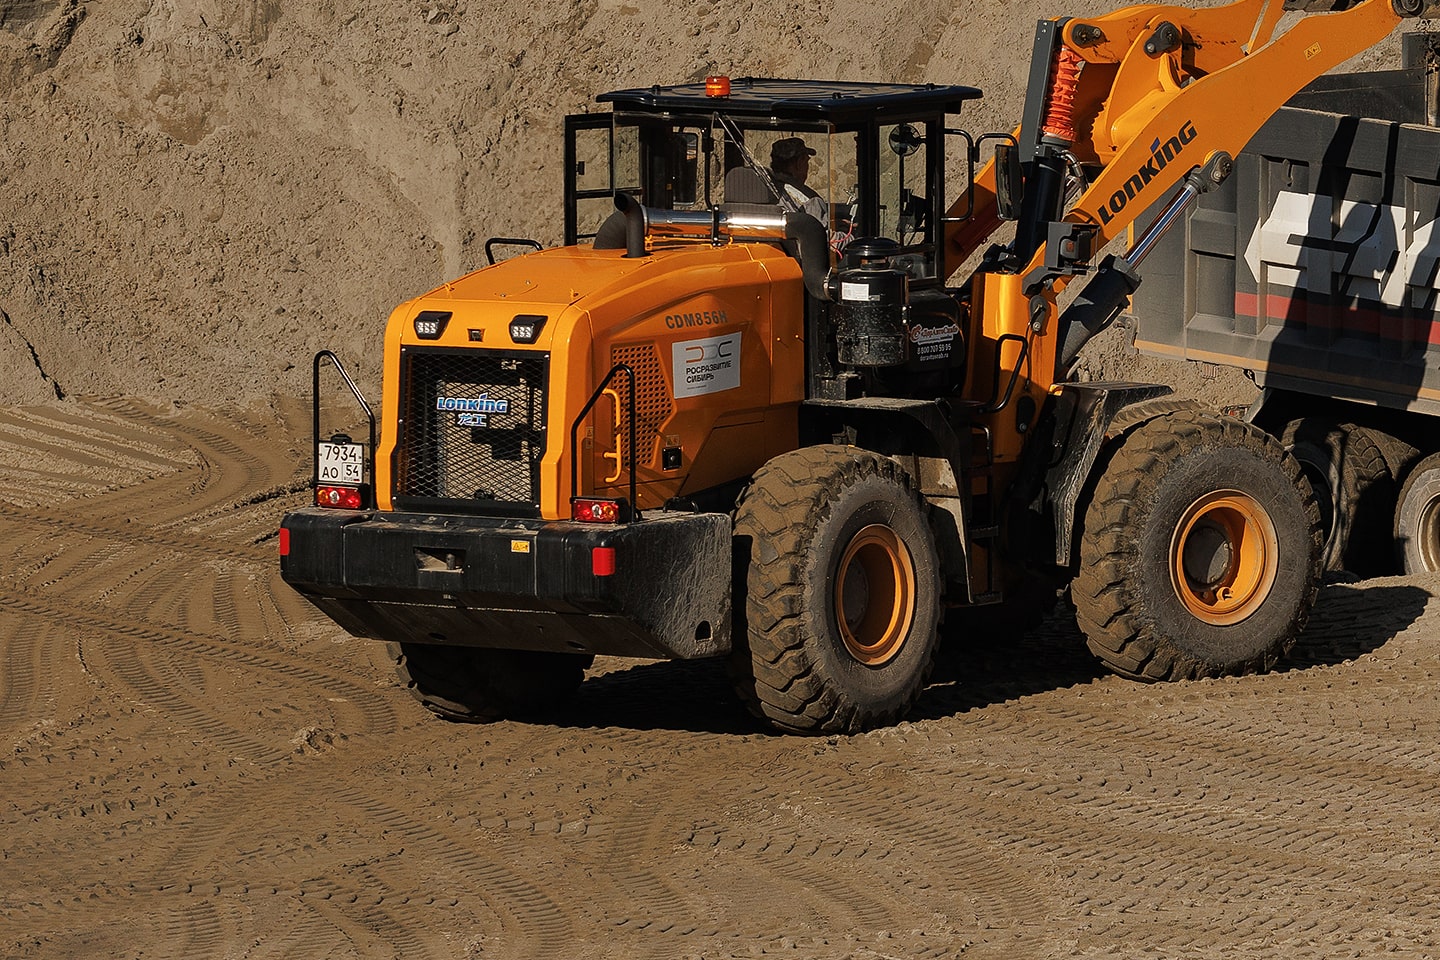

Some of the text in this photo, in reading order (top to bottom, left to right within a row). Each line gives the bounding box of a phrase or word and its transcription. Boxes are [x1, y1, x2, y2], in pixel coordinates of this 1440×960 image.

[1097, 119, 1198, 226] LONKING
[665, 311, 728, 330] CDM856H
[686, 360, 732, 375] РОСРАЗВИТИЕ
[686, 373, 715, 384] СИБИРЬ
[437, 393, 508, 413] LONKING
[324, 445, 357, 462] 7934
[346, 464, 359, 477] 54
